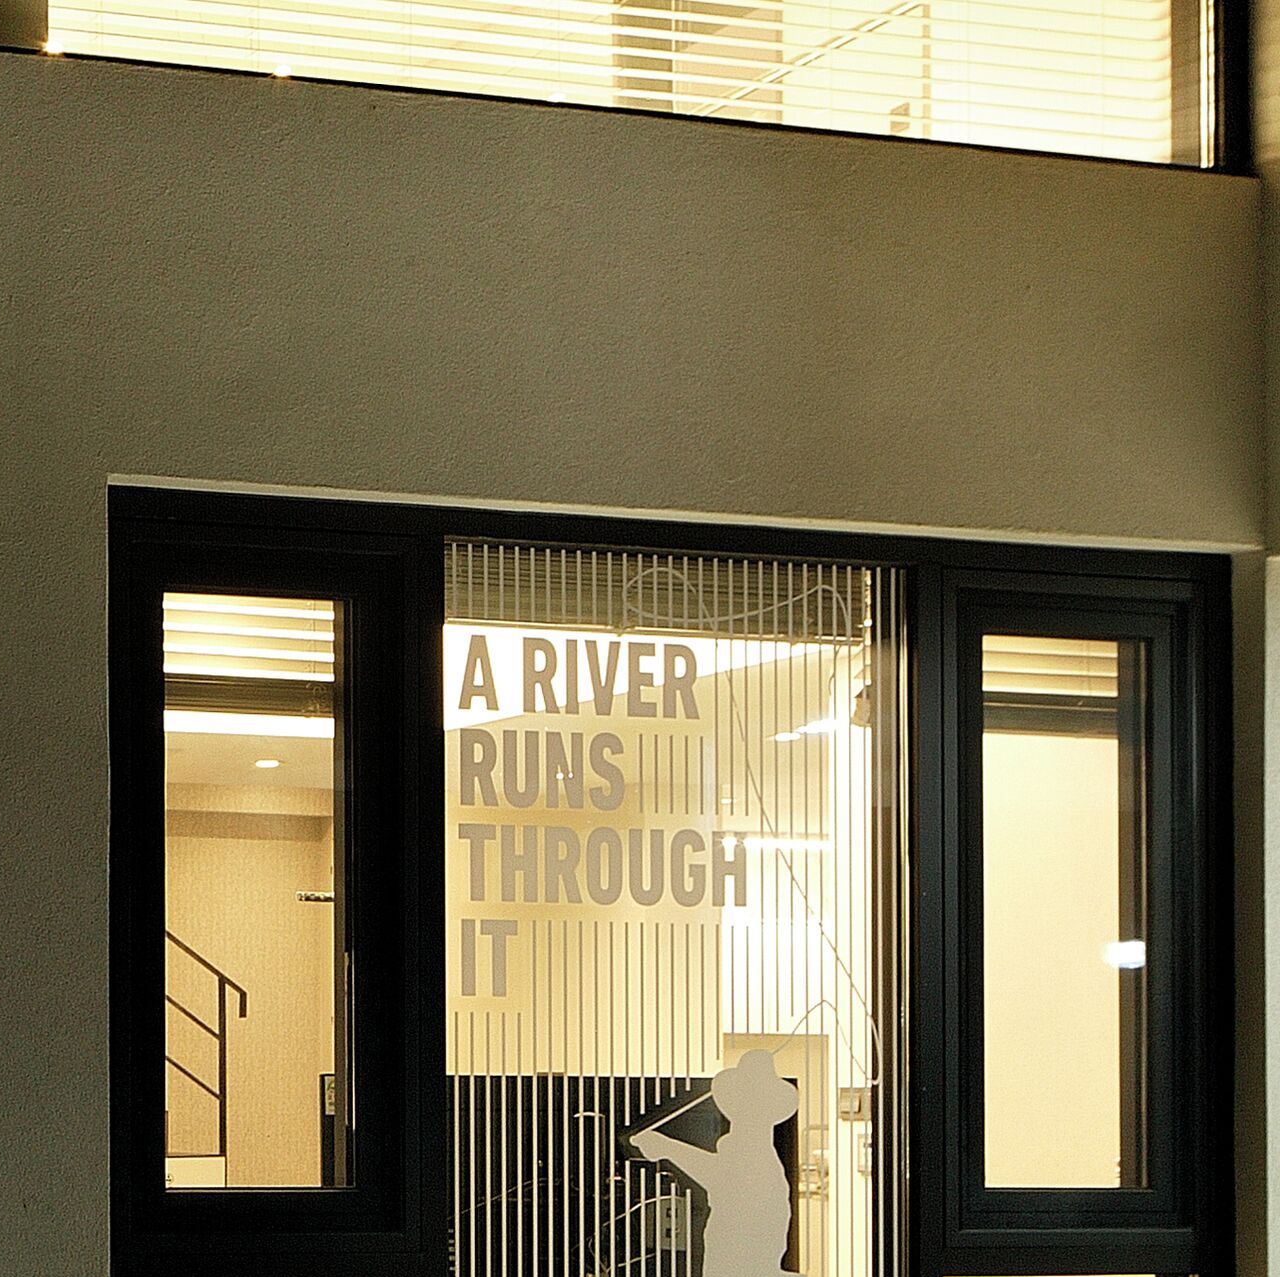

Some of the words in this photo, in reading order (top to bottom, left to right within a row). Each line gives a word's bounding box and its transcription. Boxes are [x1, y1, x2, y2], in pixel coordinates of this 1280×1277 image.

[458, 634, 500, 711] A
[522, 637, 700, 720] RIVER
[459, 728, 626, 811] RUNS
[458, 822, 747, 907] THROUGH
[460, 918, 519, 998] IT
